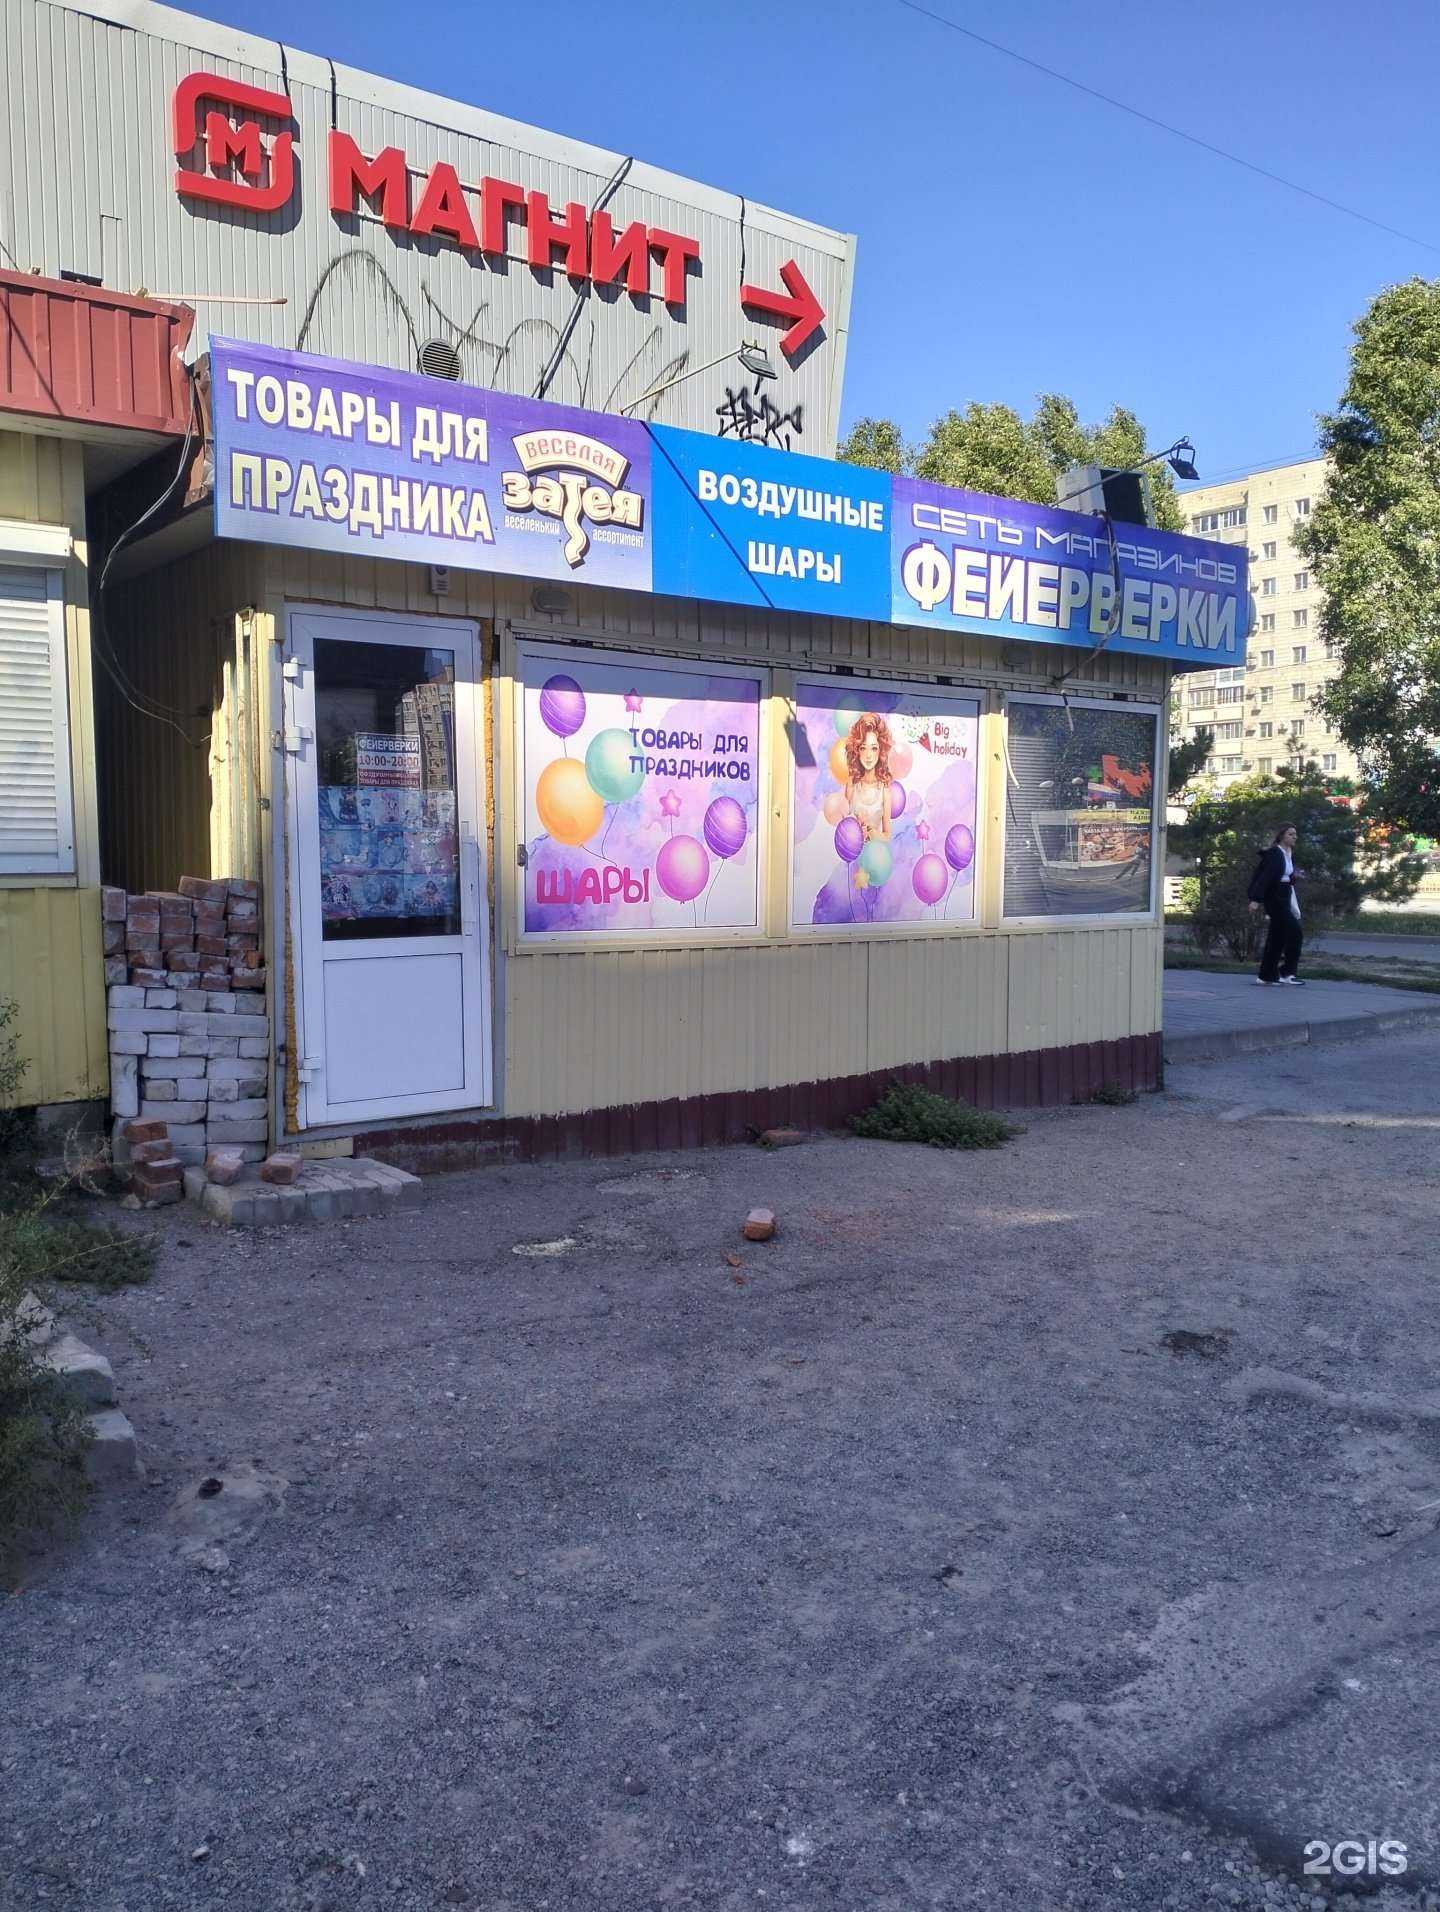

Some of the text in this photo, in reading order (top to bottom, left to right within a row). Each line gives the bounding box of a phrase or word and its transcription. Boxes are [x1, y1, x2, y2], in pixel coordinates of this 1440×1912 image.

[329, 130, 700, 304] МАГНИТ
[227, 368, 489, 464] ТОВАРЫ ДЛЯ
[230, 451, 495, 543] ПРАЗДНИКА
[698, 468, 884, 532] ВОЗДУШНЫЕ
[747, 541, 841, 584] ШАРЫ
[912, 503, 1237, 585] СЕТЬ МАГАЗИНОВ
[629, 728, 748, 755] ТОВАРЫ ДЛЯ
[933, 740, 967, 759] holiday
[934, 721, 950, 739] Big
[629, 755, 750, 781] ПРАЗДНИКОВ
[536, 865, 650, 904] ШАРЫ
